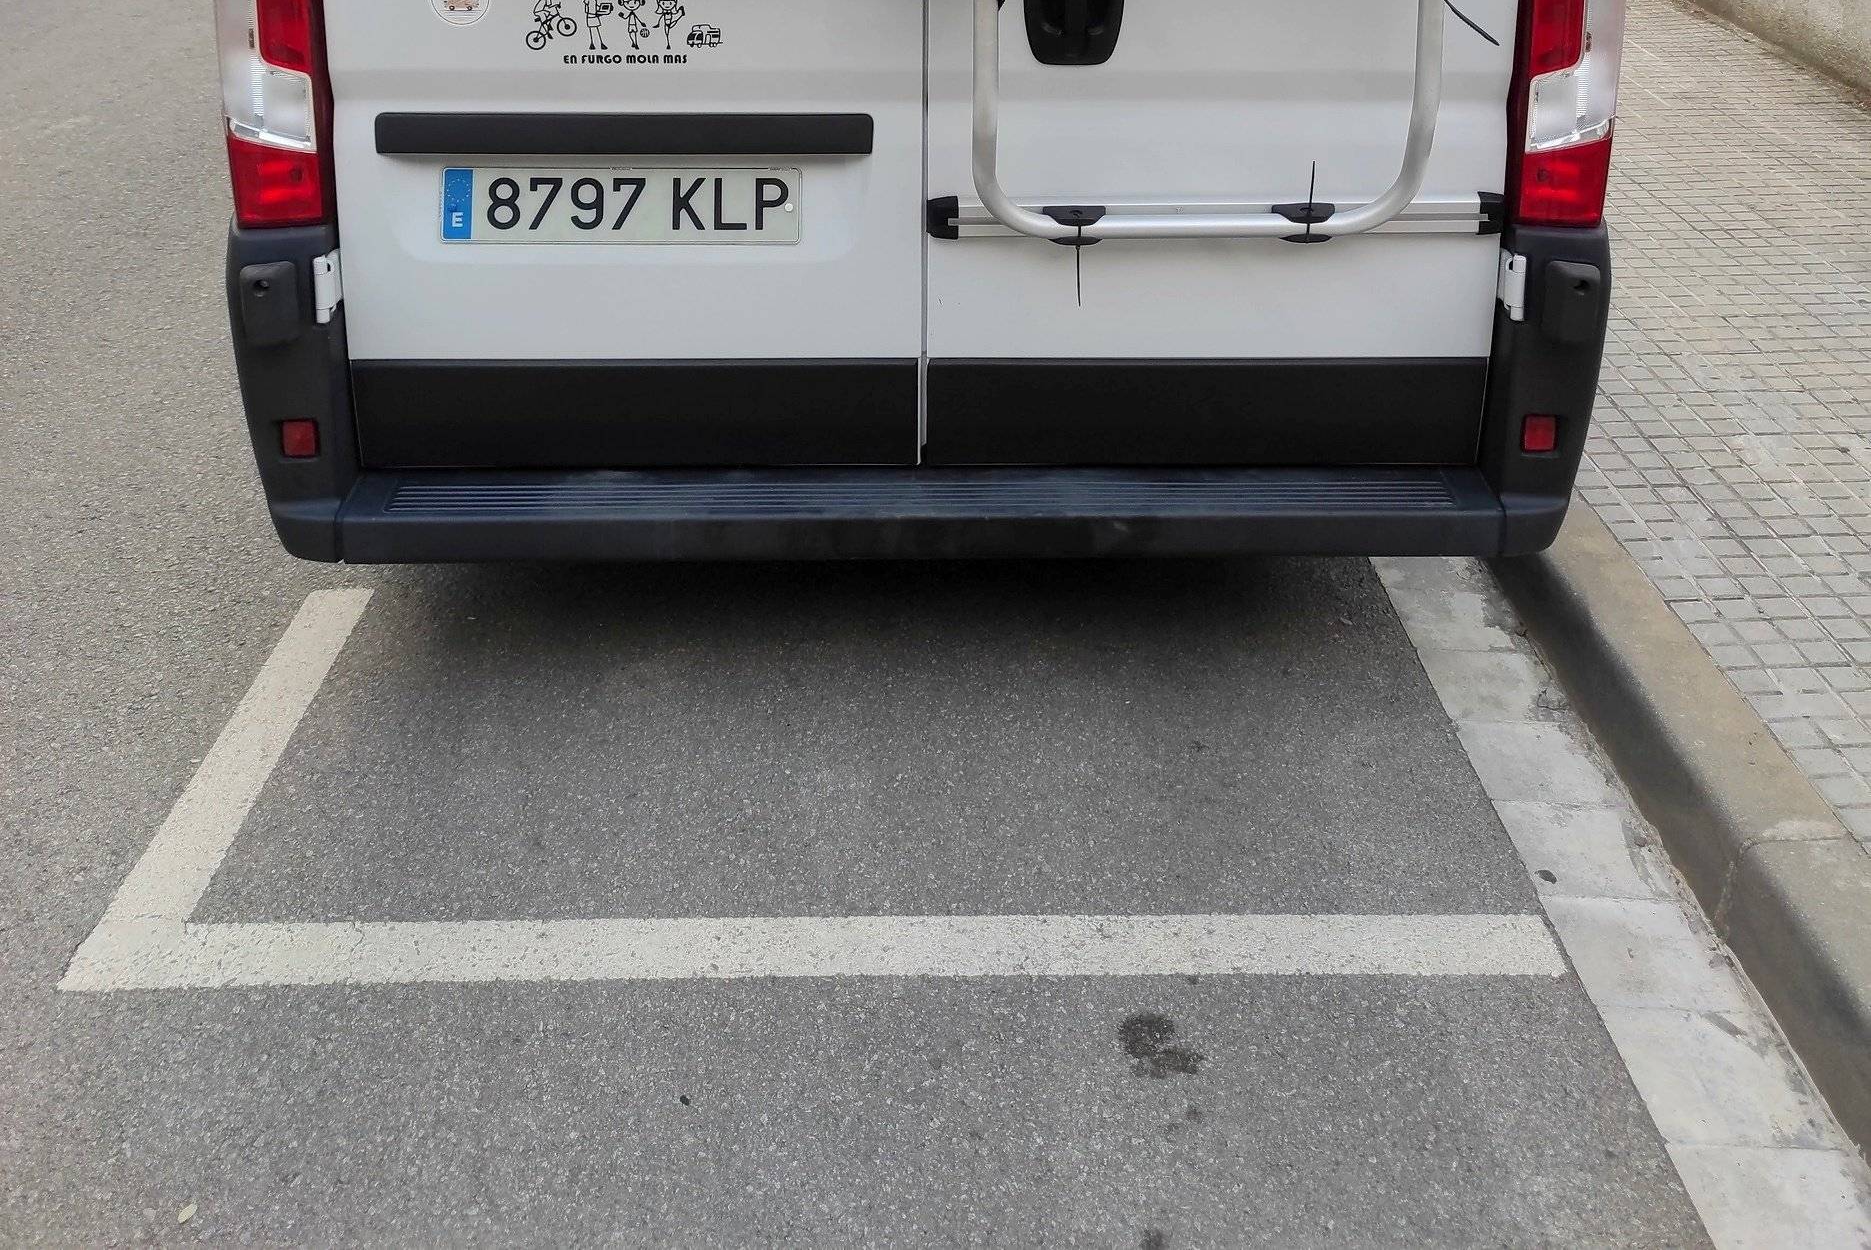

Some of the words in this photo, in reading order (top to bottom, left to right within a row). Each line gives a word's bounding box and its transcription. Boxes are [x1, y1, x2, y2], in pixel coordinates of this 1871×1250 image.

[563, 54, 578, 64] EN
[581, 54, 622, 64] FURGO
[626, 54, 660, 64] MOLA
[663, 54, 688, 64] MAS
[452, 211, 464, 228] E
[486, 176, 647, 231] 8797
[671, 177, 790, 231] KLP
